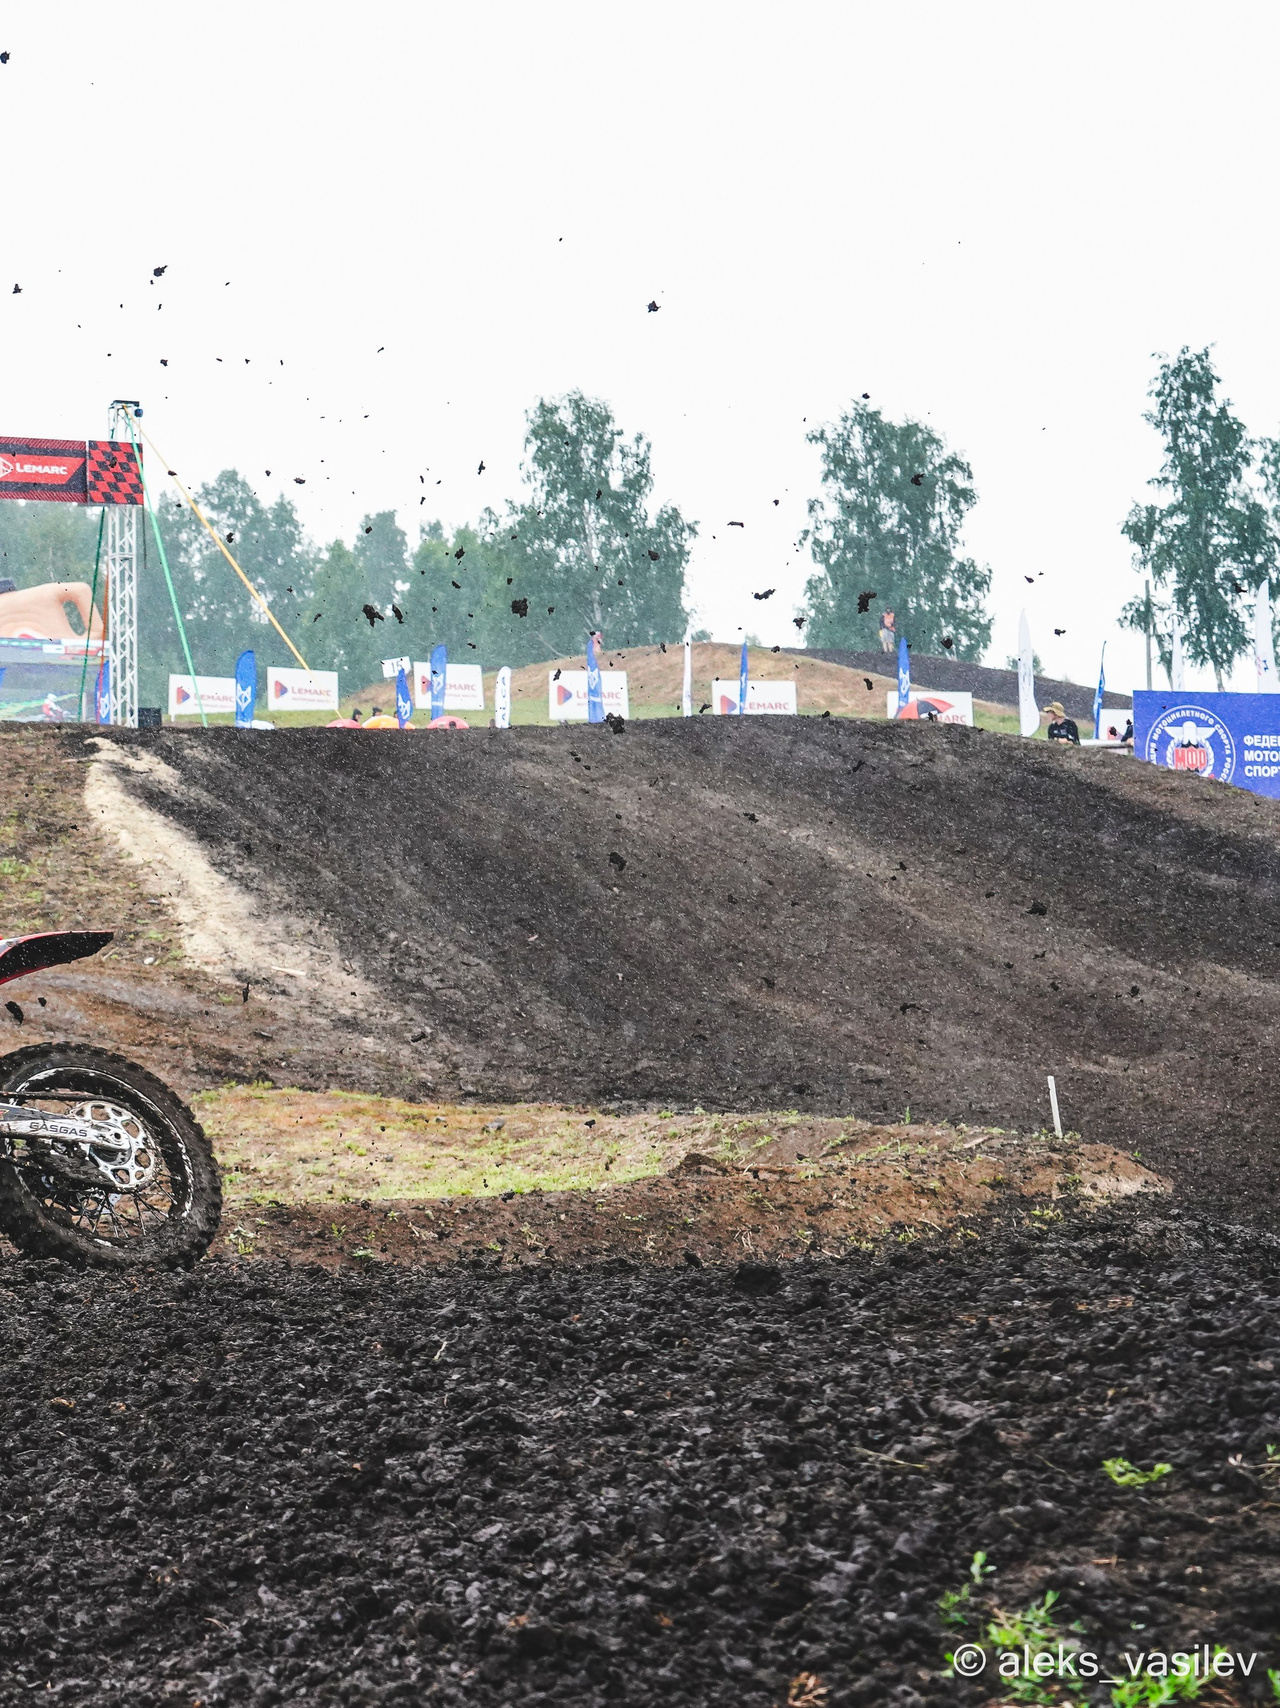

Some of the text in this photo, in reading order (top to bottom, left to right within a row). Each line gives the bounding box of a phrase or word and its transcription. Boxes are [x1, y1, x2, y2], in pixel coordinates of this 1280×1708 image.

[15, 462, 68, 475] LEMARC
[194, 692, 235, 703] LEMARC
[291, 686, 332, 698] LEMARC
[1152, 710, 1215, 741] МОТОЦИКЛЕТНОГО
[1214, 723, 1232, 755] СПОРТА
[1175, 746, 1208, 770] МФР
[1244, 750, 1280, 762] МОТО
[1219, 757, 1232, 783] РОСС
[29, 1121, 88, 1137] GASGAS
